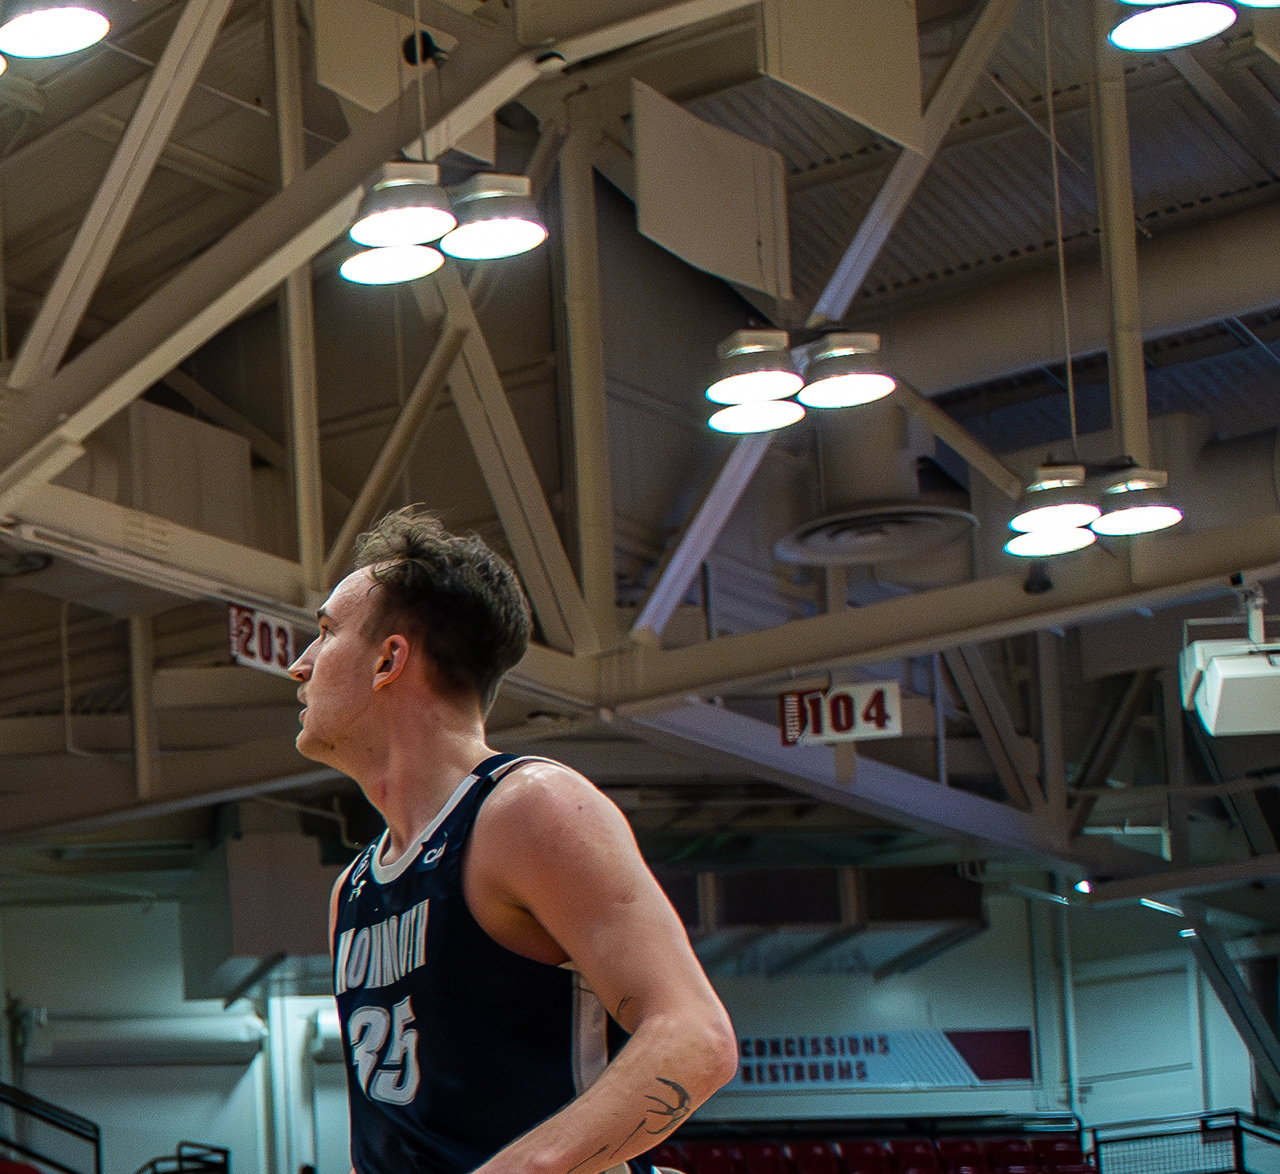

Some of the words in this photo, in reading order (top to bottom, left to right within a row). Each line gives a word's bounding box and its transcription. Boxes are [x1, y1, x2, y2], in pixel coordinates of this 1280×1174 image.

[237, 616, 289, 669] 203
[806, 688, 891, 736] 104
[348, 994, 420, 1106] 25
[740, 1034, 890, 1057] CONCESSIONS
[741, 1060, 867, 1083] RESTROOMS
